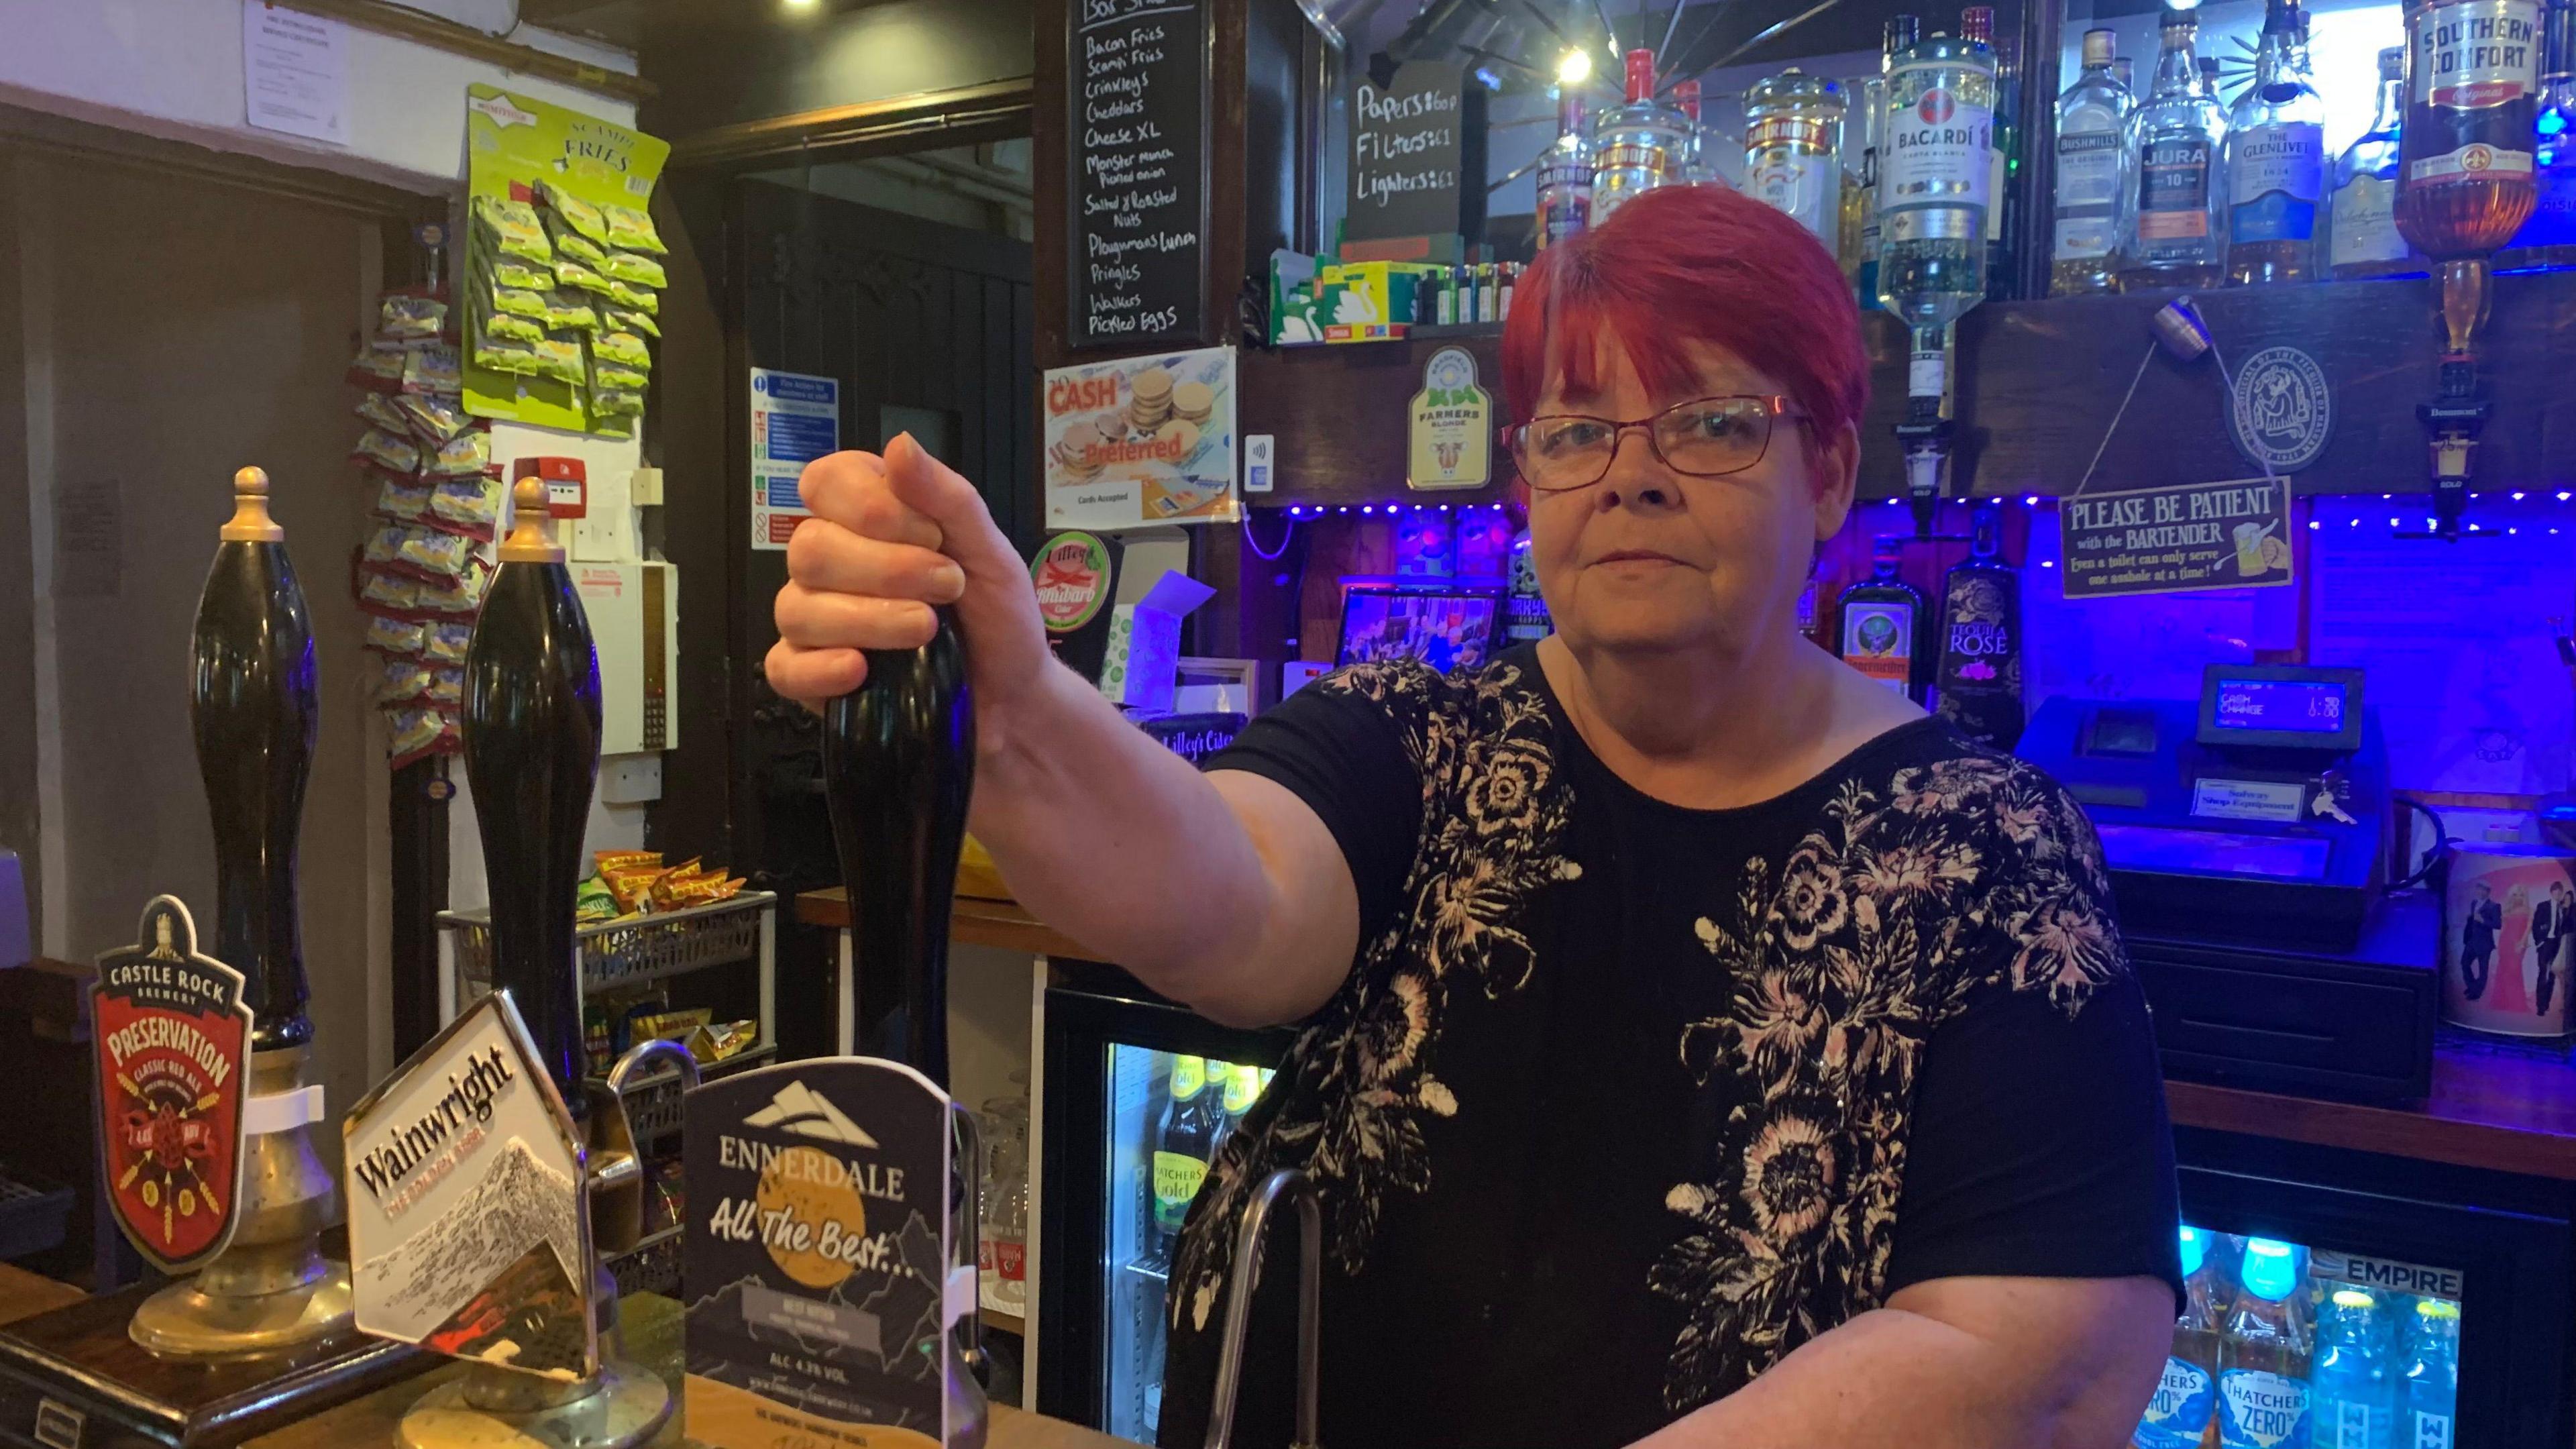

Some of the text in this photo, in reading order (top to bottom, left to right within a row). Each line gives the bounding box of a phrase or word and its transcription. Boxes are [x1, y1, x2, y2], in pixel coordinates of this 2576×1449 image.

[1087, 25, 1165, 58] Bacon Fries
[2424, 17, 2533, 52] SOUTHERN
[1132, 47, 1164, 65] Fries
[2432, 46, 2526, 76] COMFORT
[1087, 99, 1144, 121] Cheddars
[1085, 121, 1161, 148] Cheese XL
[1899, 125, 1974, 148] BACARDÍ
[2060, 136, 2116, 151] BUSHMILLS
[565, 139, 632, 172] FRIES
[2144, 149, 2206, 166] JURA
[2243, 142, 2308, 158] GLENLIVET
[1086, 154, 1135, 175] Monster
[2167, 174, 2182, 186] 10
[1131, 186, 1177, 209] Roasted
[1114, 213, 1142, 228] Nuts
[1091, 263, 1140, 290] Pringles
[1089, 292, 1141, 315] Walkers
[1089, 305, 1177, 335] Pickled Eggs
[1049, 377, 1117, 417] CASH
[1419, 409, 1480, 422] FARMERS
[1084, 433, 1183, 463] Preferred
[2071, 486, 2273, 530] PLEASE BE PATIENT
[2078, 523, 2224, 549] with the BARTENDER
[2071, 557, 2094, 572] Even
[2107, 555, 2136, 567] toilet
[2139, 555, 2159, 564] can
[2162, 551, 2186, 564] only
[2189, 550, 2218, 561] serve
[2089, 576, 2107, 585] one
[2154, 570, 2165, 581] at
[1036, 586, 1095, 603] Rhubarb
[1951, 624, 2006, 637] TEQUILA
[1949, 637, 2007, 655] ROSE
[2221, 703, 2264, 715] CHANGE
[111, 965, 225, 1004] CASTLE ROCK
[138, 987, 196, 1005] BREWERY
[107, 1016, 231, 1087] PRESERVATION
[134, 1059, 166, 1081] CLASSIC
[168, 1060, 185, 1078] RED
[186, 1072, 202, 1094] ALE
[355, 1044, 513, 1198] Wainwright
[719, 1135, 904, 1202] ENNERDALE
[710, 1197, 757, 1242] All
[762, 1205, 811, 1252] The
[2349, 1260, 2459, 1295] EMPIRE
[2227, 1379, 2307, 1408] THATCHERS
